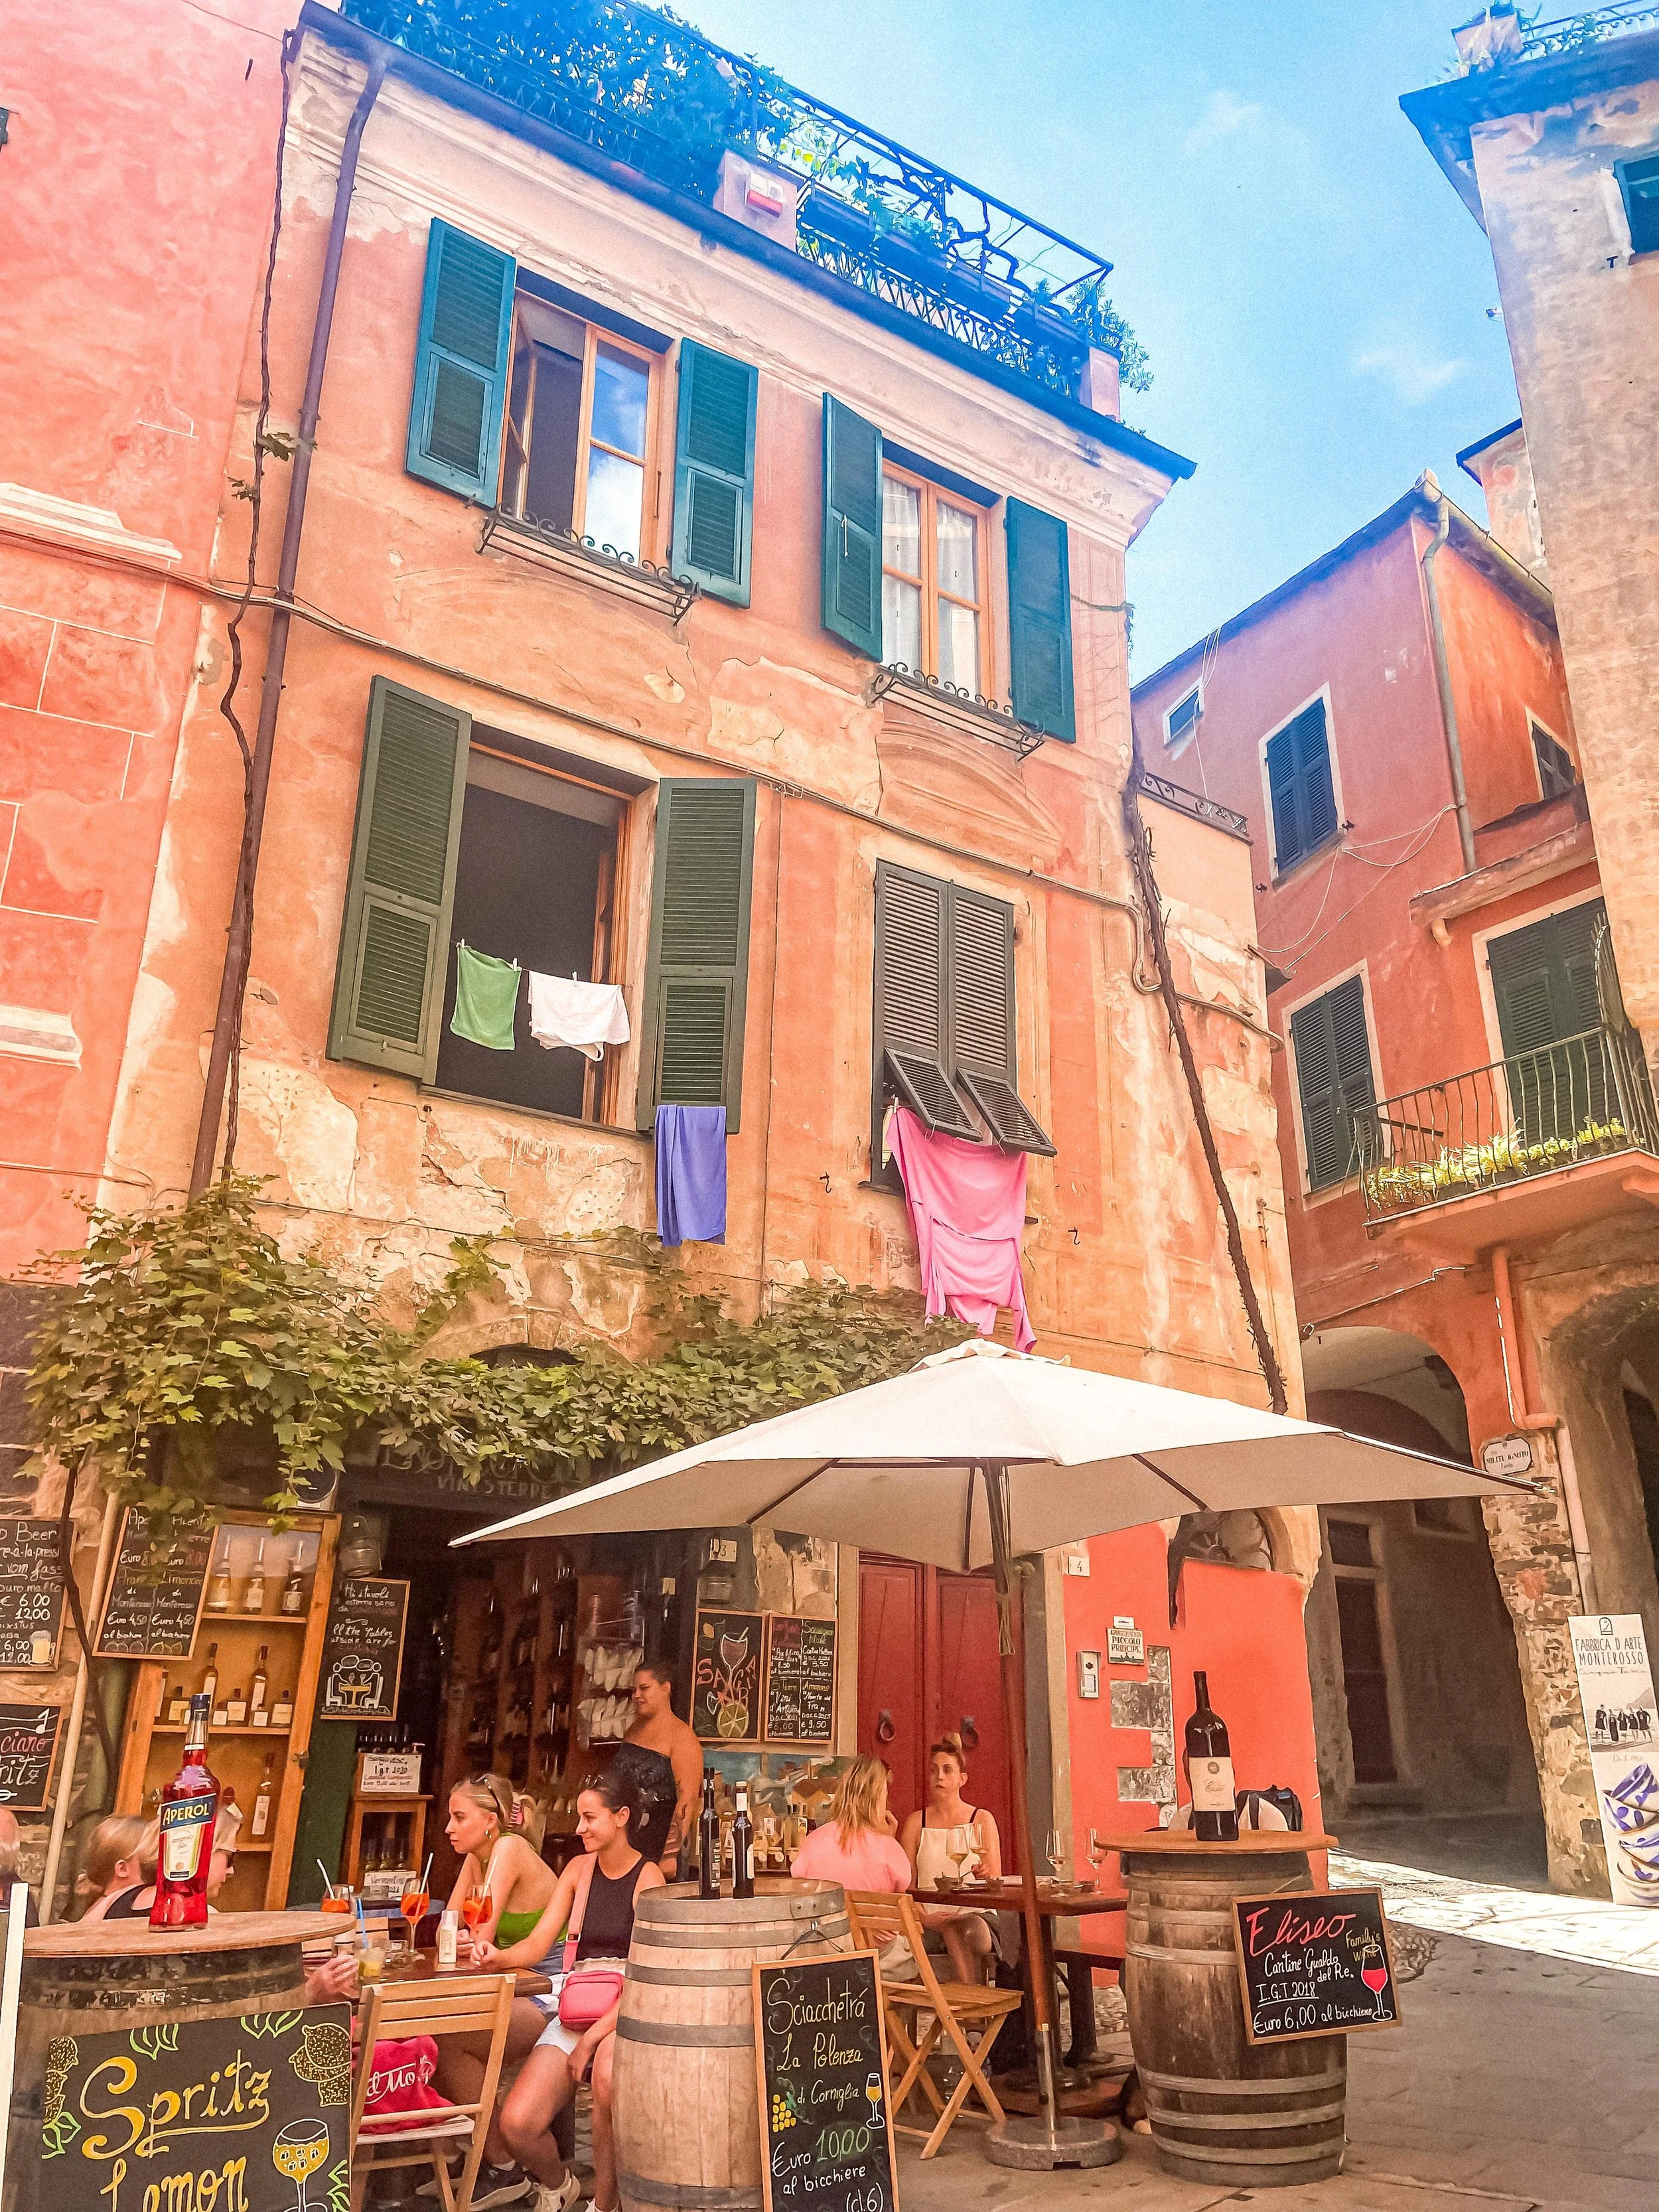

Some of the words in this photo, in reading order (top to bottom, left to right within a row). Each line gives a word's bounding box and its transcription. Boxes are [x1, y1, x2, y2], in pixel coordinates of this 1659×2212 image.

[16, 1521, 57, 1542] Beer
[1076, 1560, 1082, 1572] 4
[1111, 1644, 1141, 1653] PRINCIPE
[1112, 1635, 1141, 1645] PICCOLO
[1575, 1638, 1612, 1652] FABBRICA
[1624, 1637, 1643, 1651] ARTE
[1579, 1651, 1644, 1666] MONTEROSSO
[808, 1720, 827, 1729] 9,50
[163, 1803, 210, 1826] APEROL
[1246, 1907, 1356, 1956] Eliseo
[1265, 1951, 1302, 1977] Cantine
[1317, 1966, 1332, 1983] del
[1292, 1981, 1316, 1998] 2018
[1284, 2004, 1317, 2029] 6,00
[1321, 2004, 1333, 2022] al
[776, 2033, 802, 2072] La
[813, 2032, 864, 2069] Polenza
[80, 2049, 273, 2160] Spritz
[797, 2087, 806, 2104] di
[811, 2079, 860, 2112] Corniglia
[816, 2126, 870, 2162] 10,00
[783, 2175, 798, 2195] al
[804, 2166, 866, 2192] bicchiere
